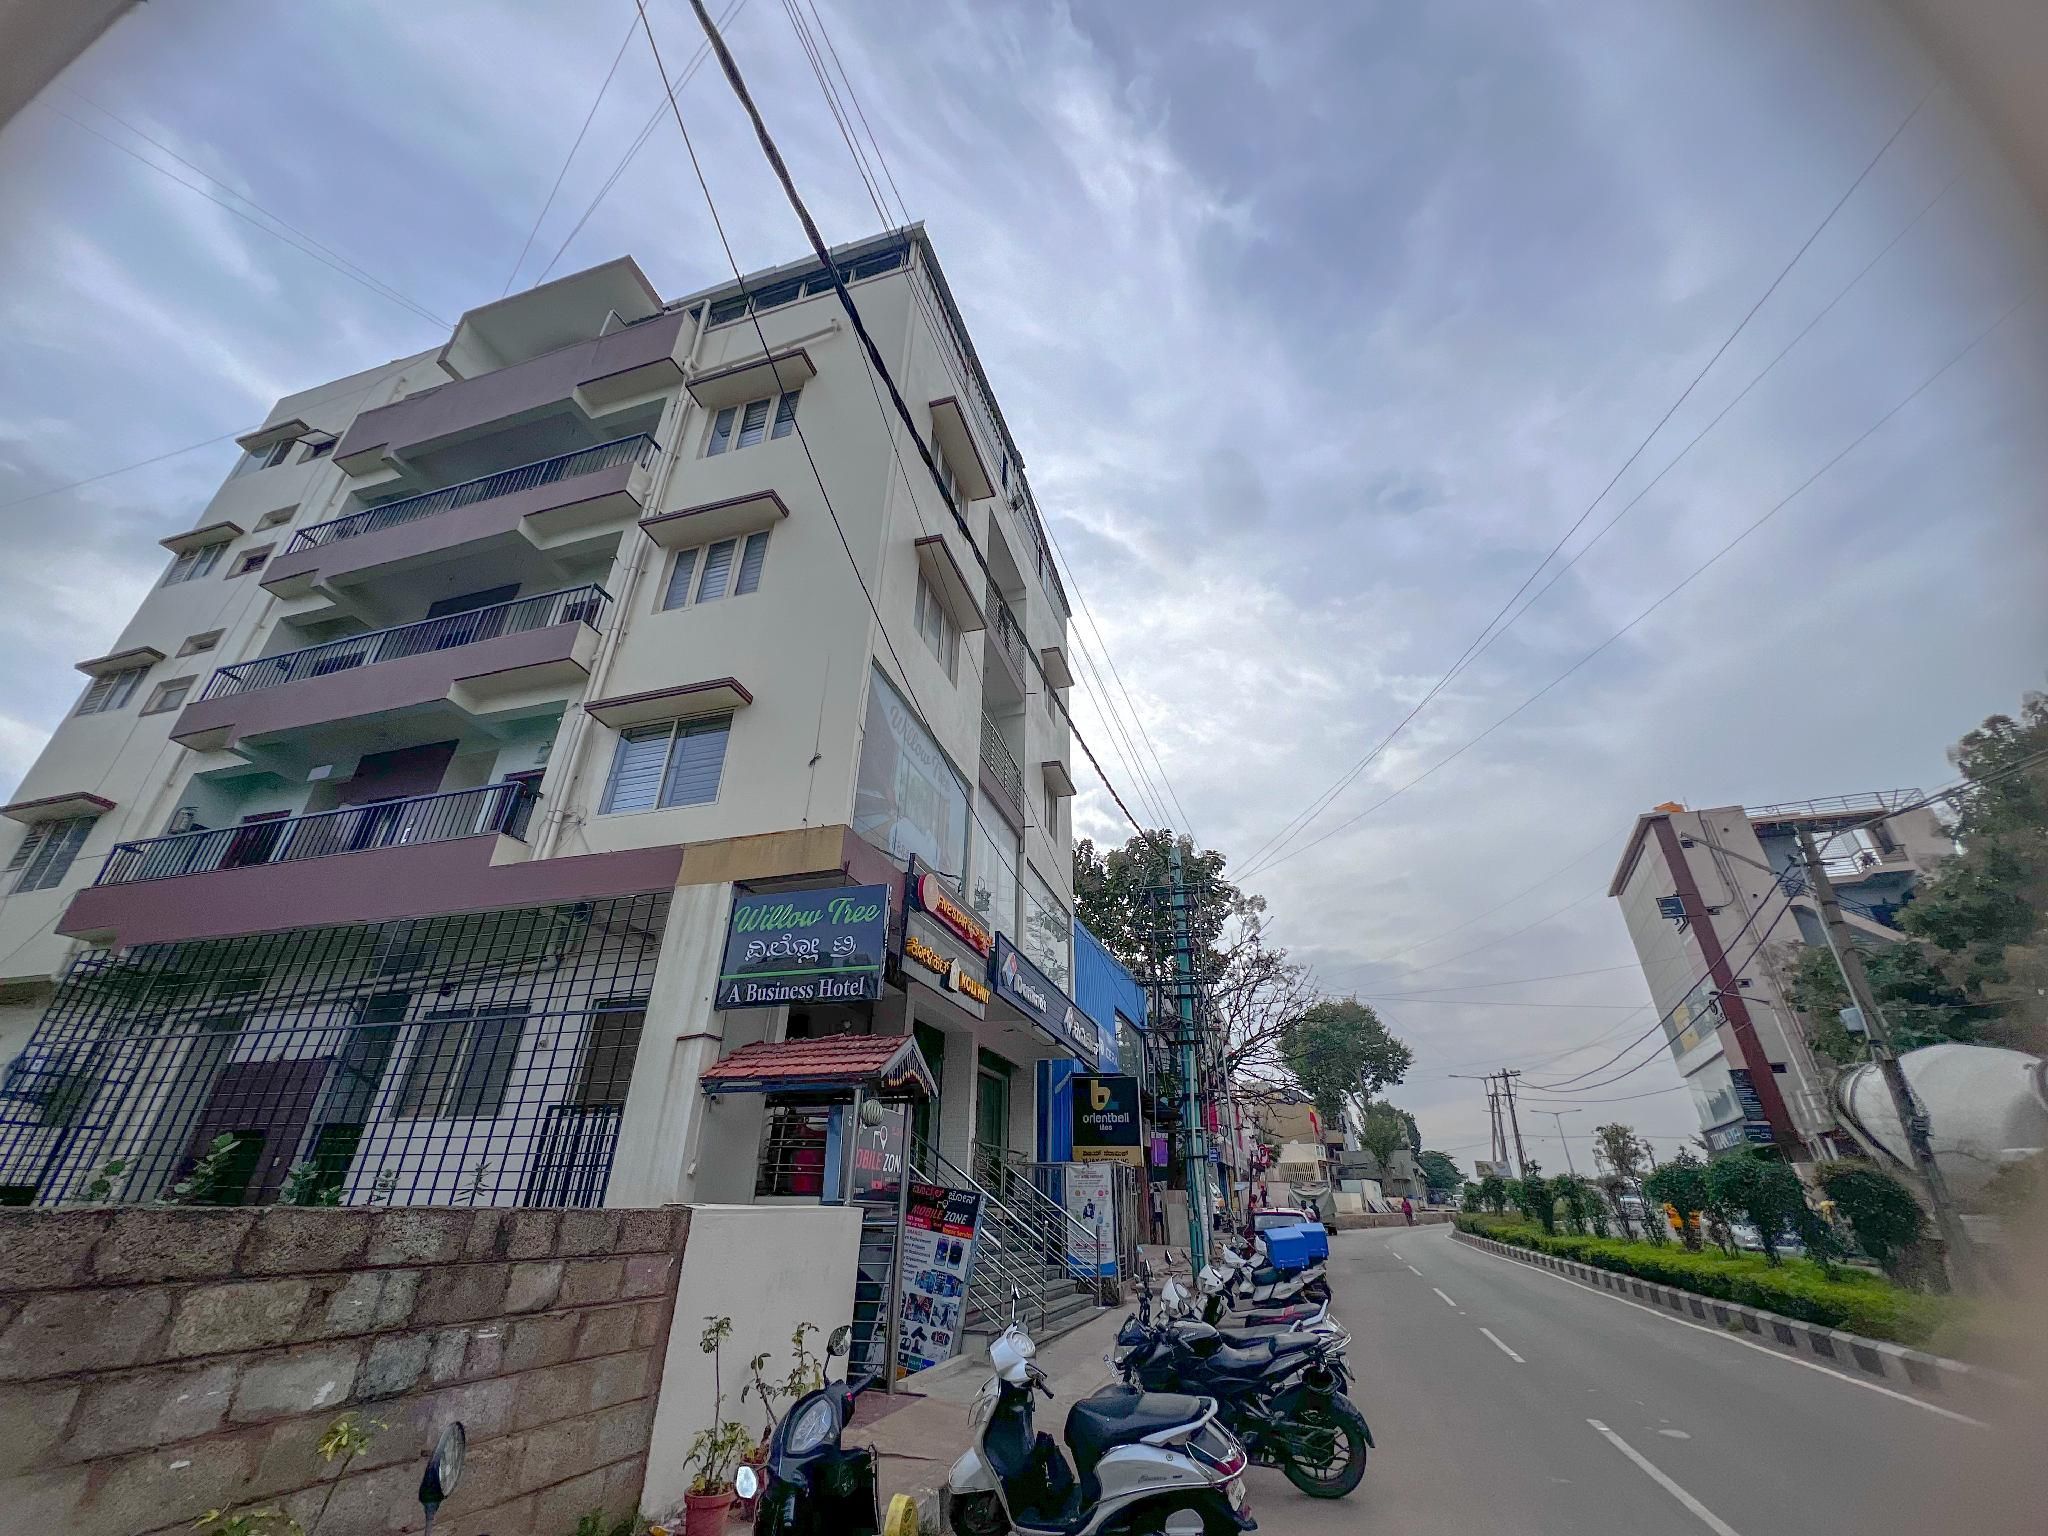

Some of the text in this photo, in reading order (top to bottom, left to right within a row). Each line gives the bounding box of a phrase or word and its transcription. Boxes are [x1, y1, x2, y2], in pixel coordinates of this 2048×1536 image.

[734, 897, 881, 934] Willow Tree
[726, 976, 865, 1003] A Business Hotel
[882, 1153, 902, 1173] ZON
[911, 1203, 944, 1220] MOBILE
[943, 1210, 969, 1225] ZONE
